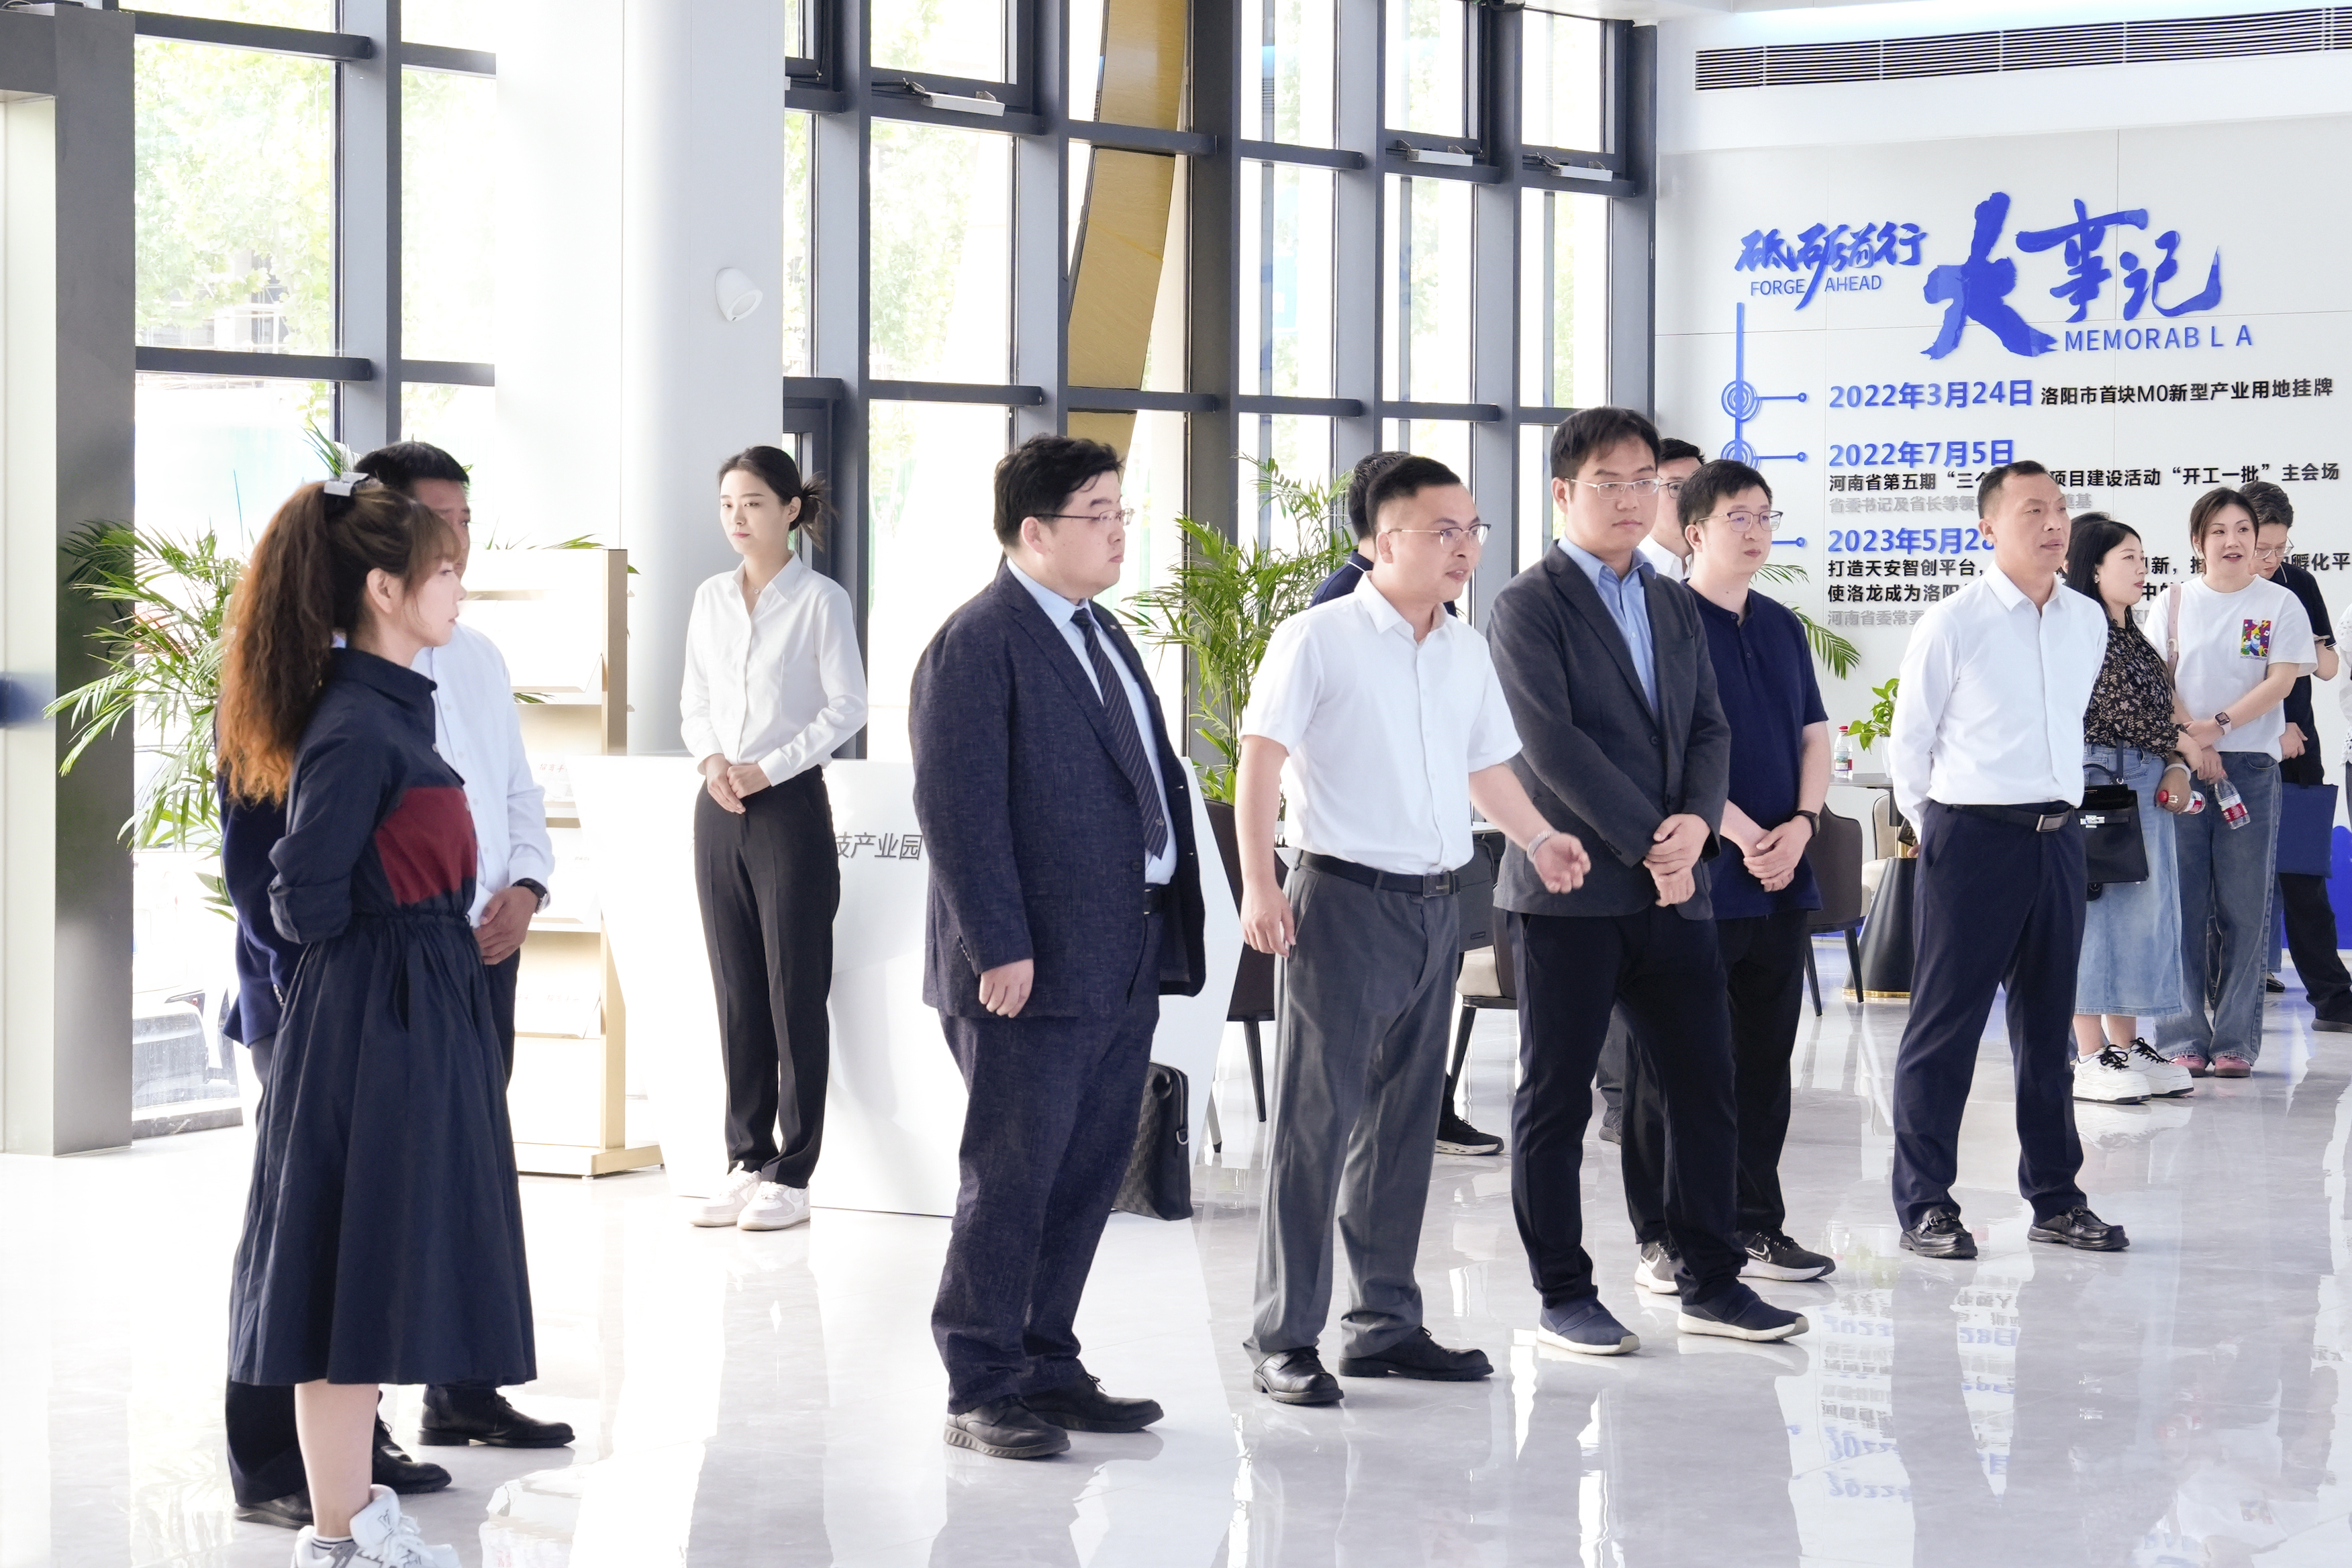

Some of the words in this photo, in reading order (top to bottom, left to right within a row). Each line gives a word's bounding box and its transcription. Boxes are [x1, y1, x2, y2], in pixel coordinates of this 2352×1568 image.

[1751, 278, 1806, 296] FORGE
[1824, 275, 1883, 293] AHEAD
[1920, 192, 2222, 360] 大事记
[1829, 379, 2032, 409] 2022年3月24日
[2041, 378, 2333, 405] 洛阳市首块M0新型产业用地挂牌
[1828, 440, 2014, 469] 2022年7月5日
